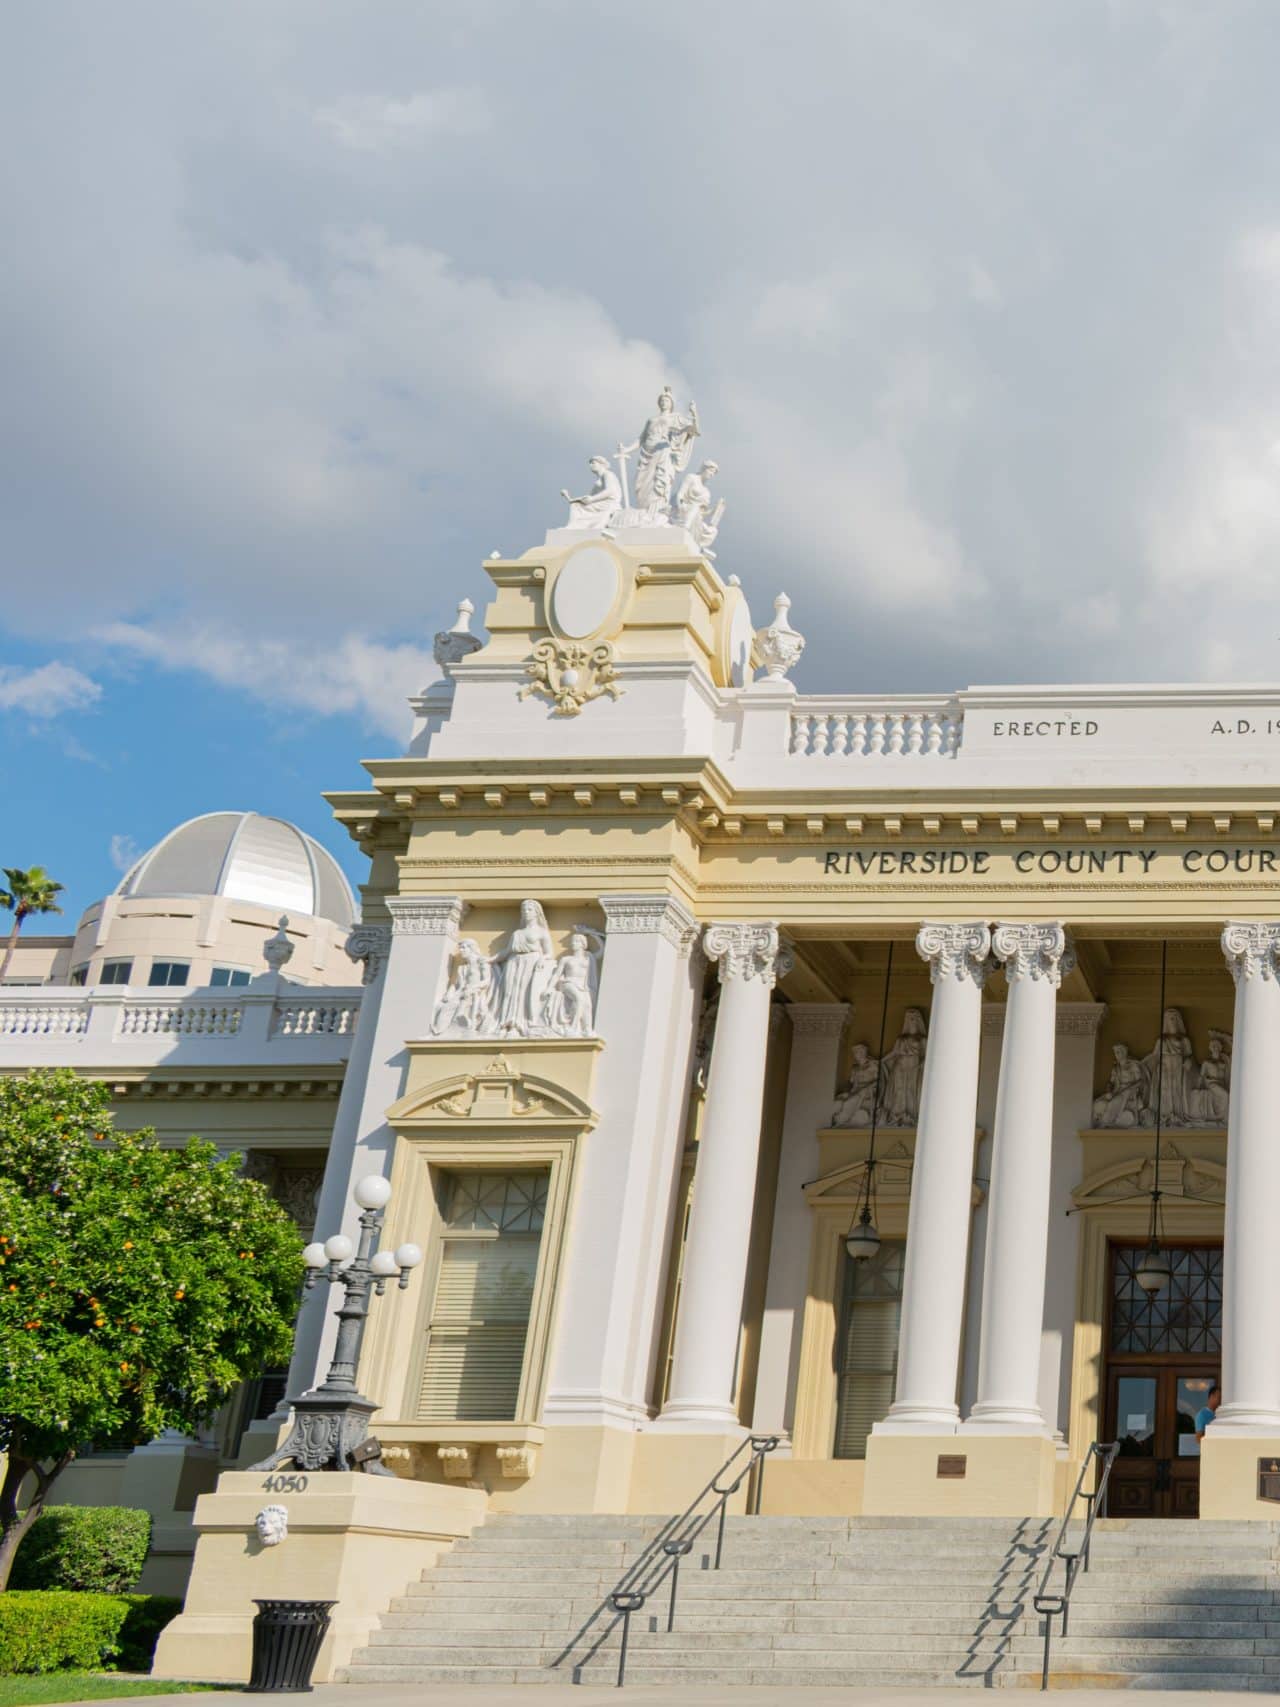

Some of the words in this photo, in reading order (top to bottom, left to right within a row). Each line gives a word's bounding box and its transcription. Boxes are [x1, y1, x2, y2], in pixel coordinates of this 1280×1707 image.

[992, 720, 1099, 737] ERECTED
[1210, 719, 1257, 735] A.D.
[823, 850, 991, 874] RIVERSIDE
[1015, 850, 1155, 874] COUNTY
[260, 1474, 309, 1494] 4050
